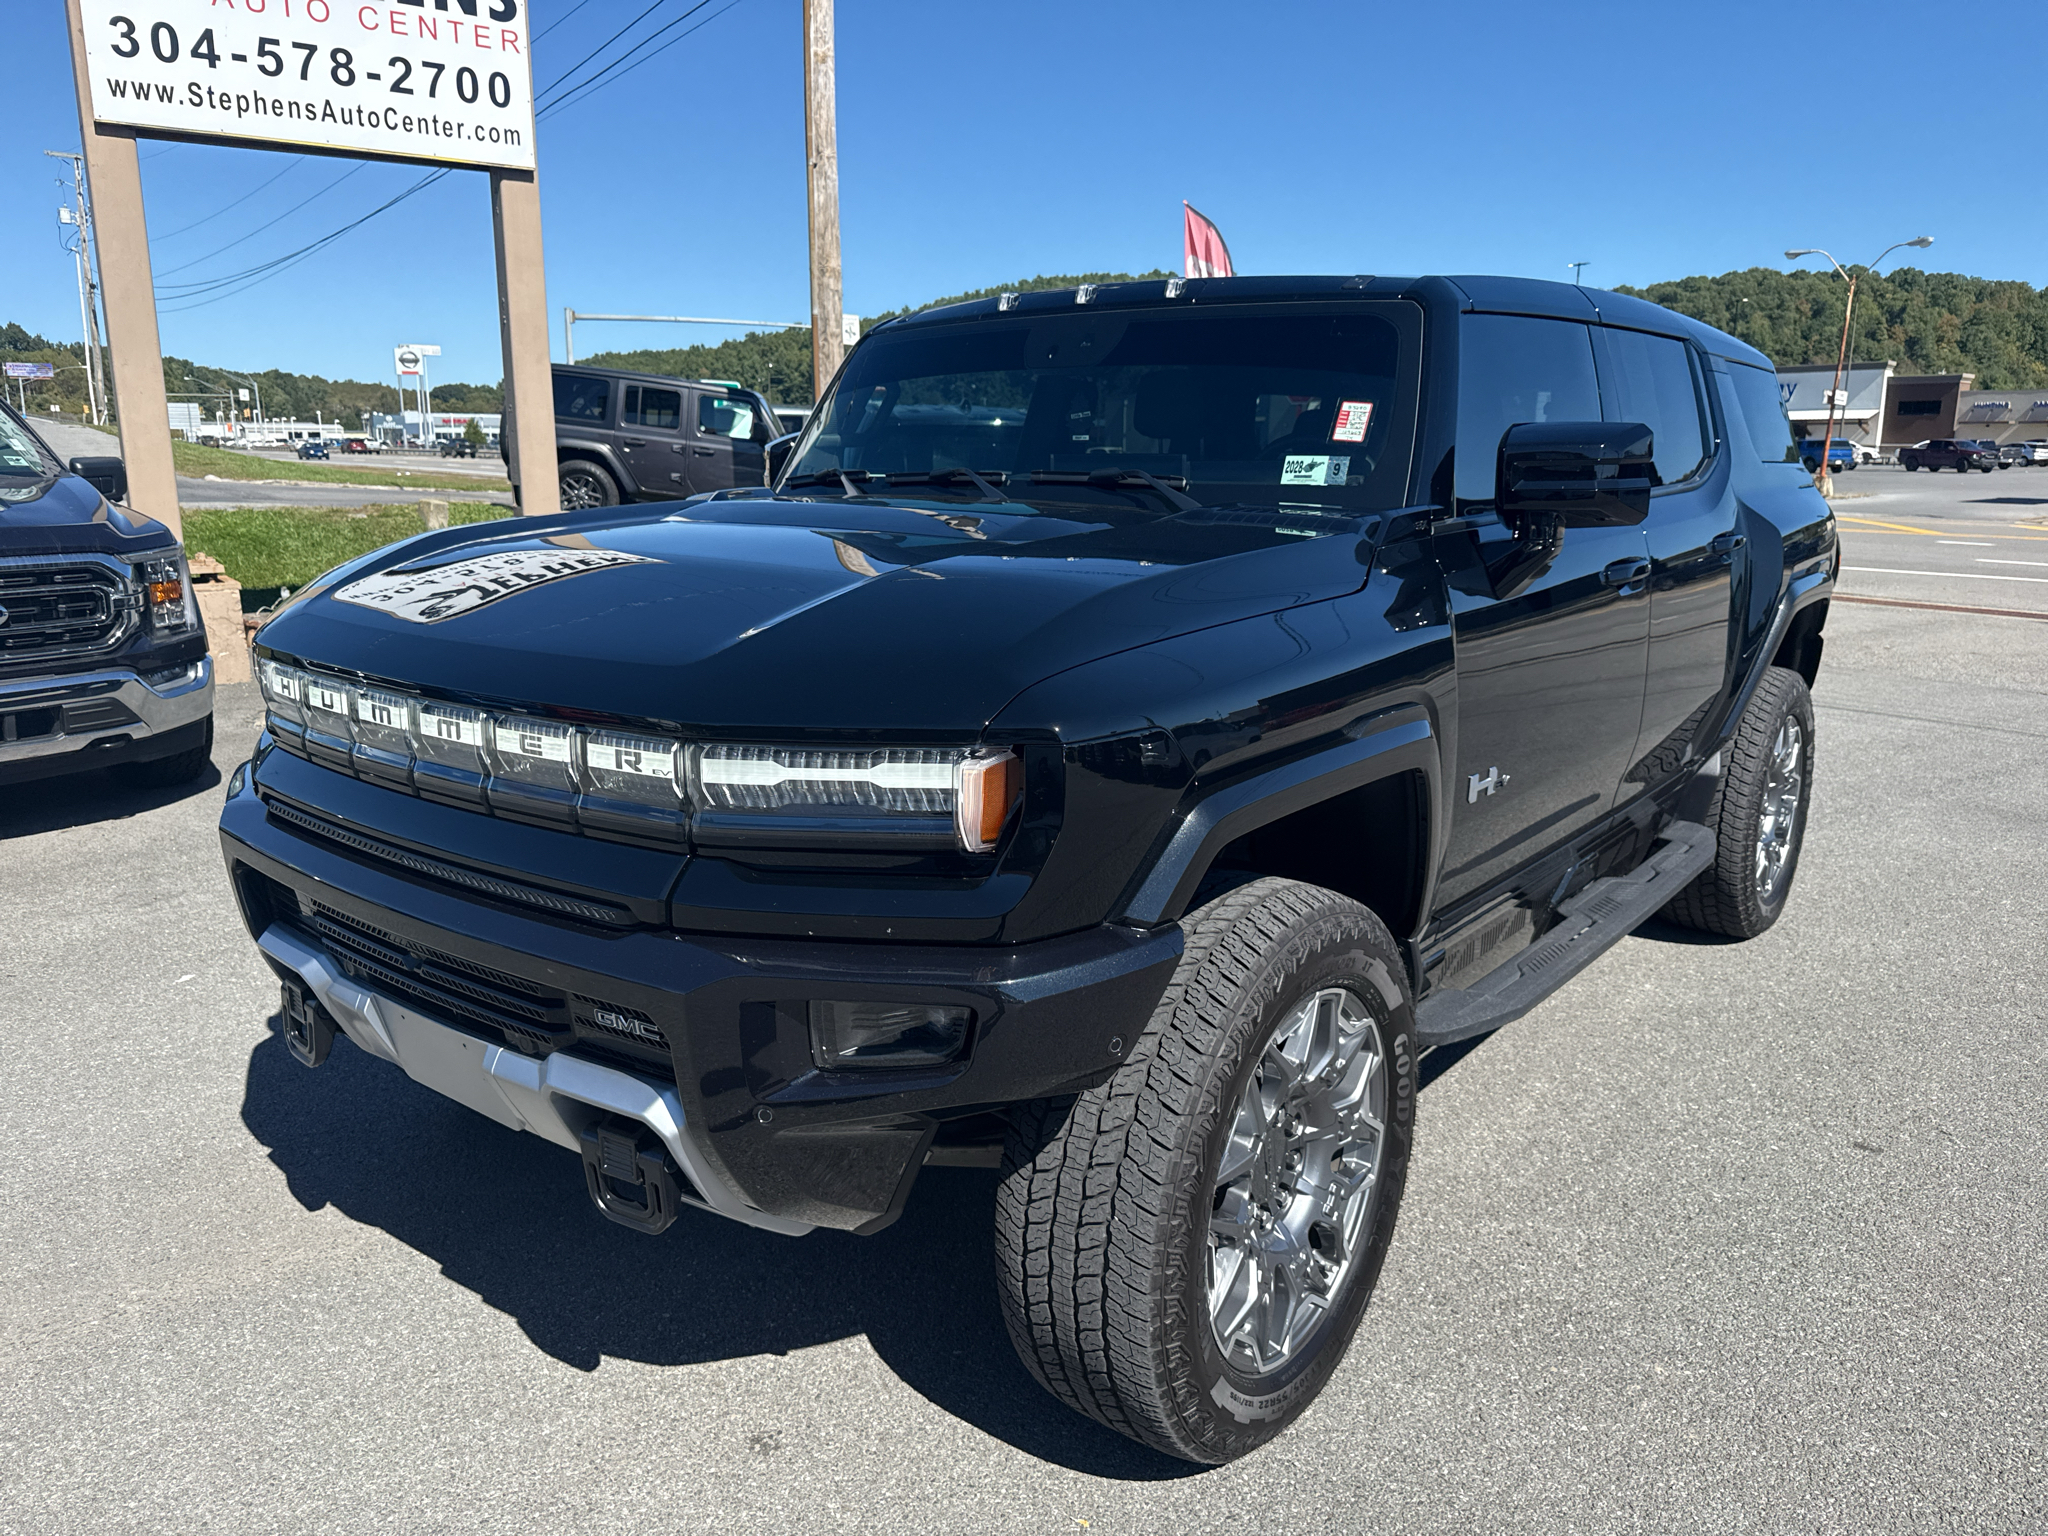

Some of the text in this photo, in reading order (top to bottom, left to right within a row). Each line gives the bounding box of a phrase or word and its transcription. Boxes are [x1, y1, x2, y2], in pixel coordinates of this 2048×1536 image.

[358, 6, 522, 54] CENTER
[108, 15, 512, 109] 304-578-2700
[106, 76, 522, 147] www.StephensAutoCenter.com
[1332, 462, 1341, 476] 9
[279, 677, 643, 773] HUMMER
[593, 1008, 661, 1041] GMC
